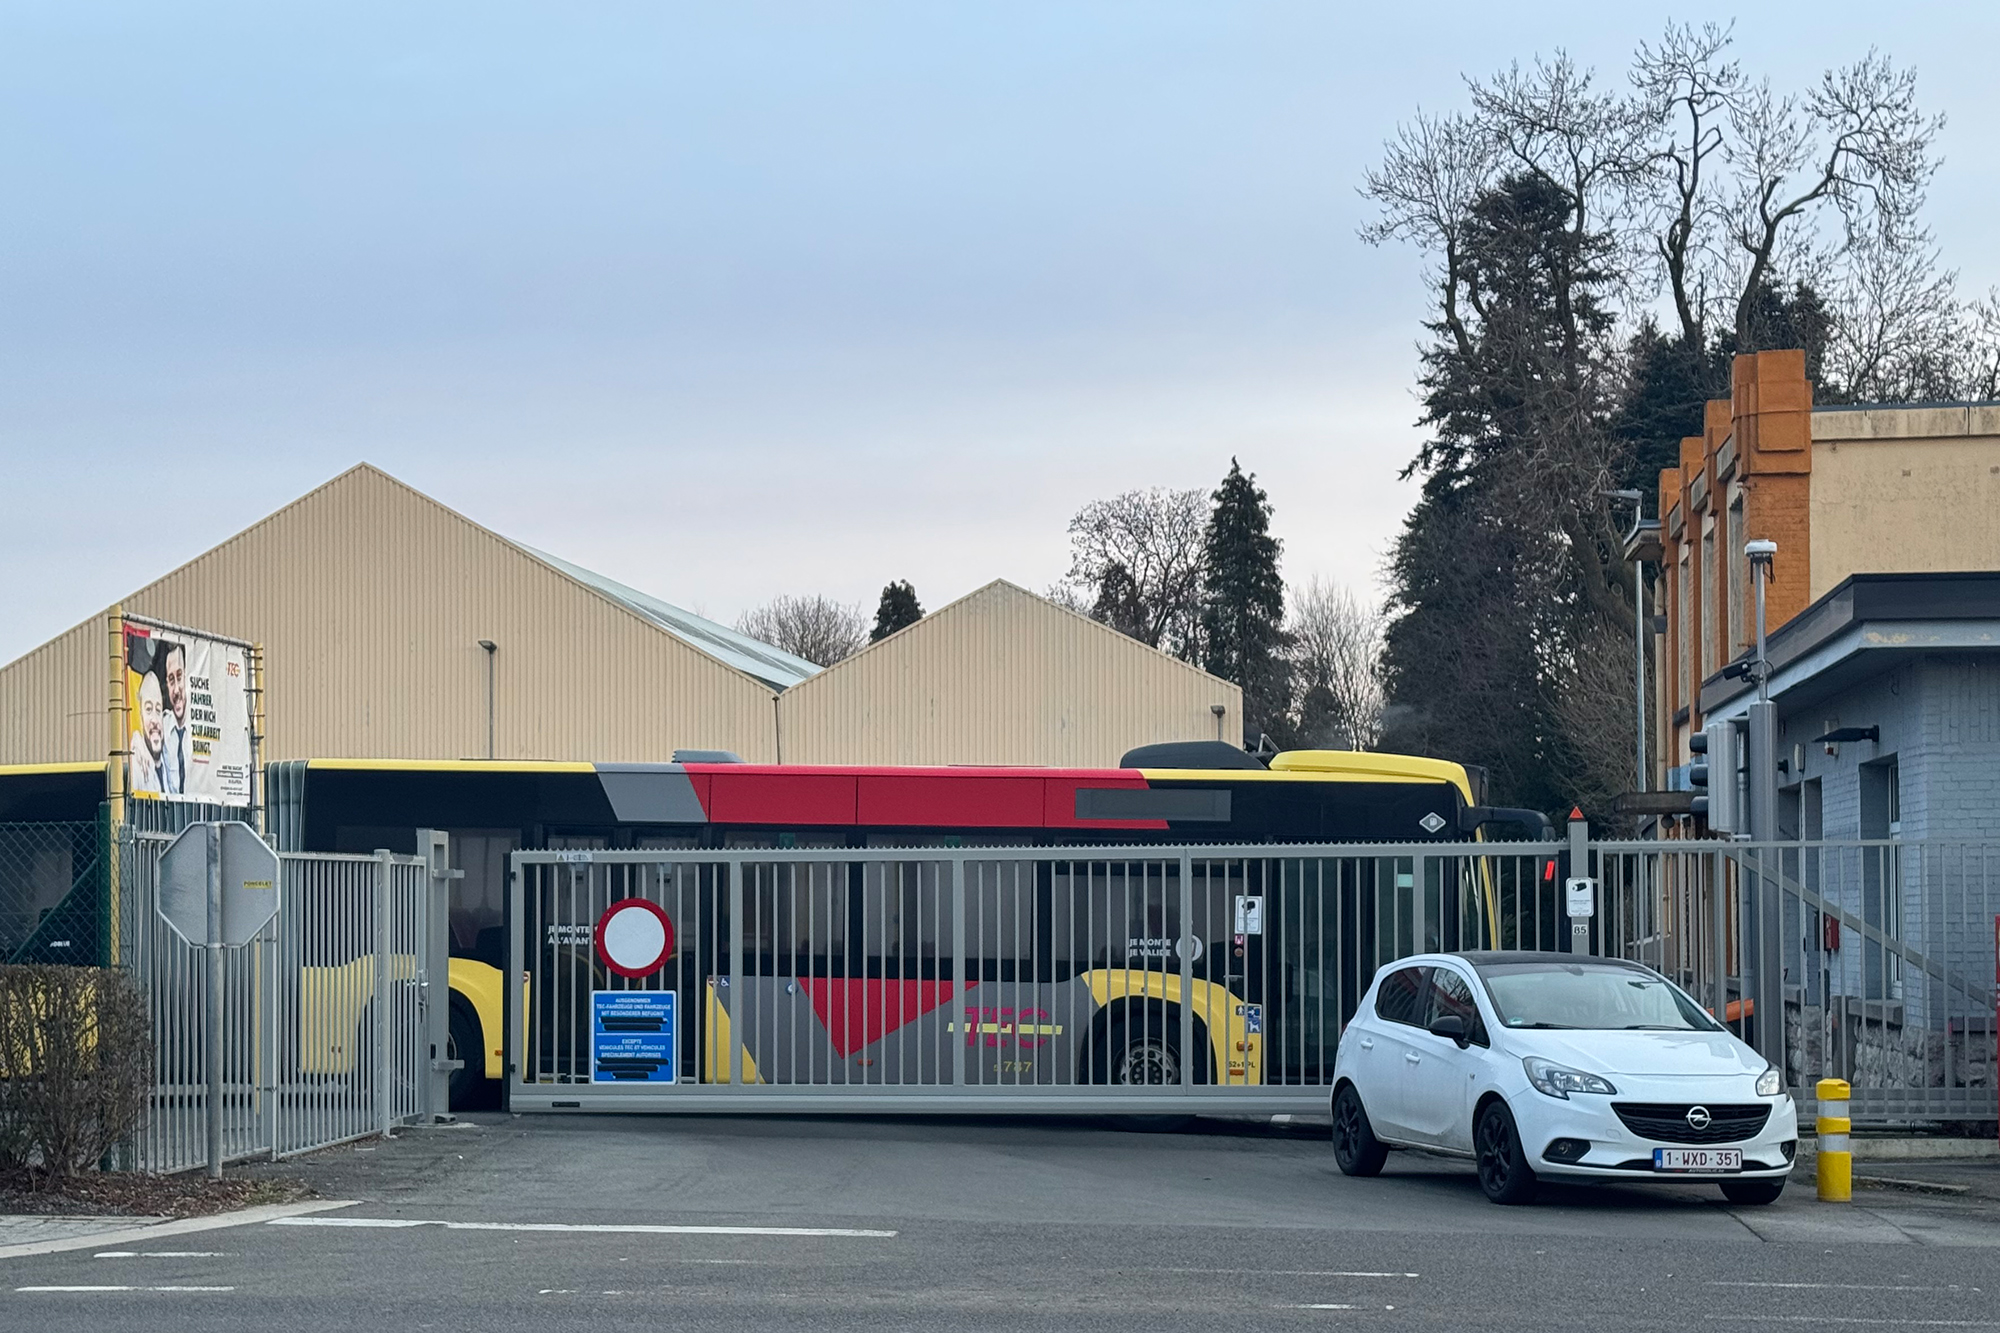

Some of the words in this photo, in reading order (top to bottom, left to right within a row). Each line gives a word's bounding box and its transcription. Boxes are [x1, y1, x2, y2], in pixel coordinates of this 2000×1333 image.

[227, 662, 240, 677] TEC
[190, 676, 210, 691] SUCHE
[190, 692, 214, 710] FAHRER,
[190, 708, 203, 721] DER
[203, 711, 216, 724] MICH
[191, 725, 203, 738] ZUR
[204, 728, 221, 741] ARBEIT
[192, 741, 212, 755] BRINGT.
[547, 925, 555, 935] JE
[556, 936, 592, 945] 'AVAN
[1129, 938, 1138, 947] JE
[1129, 949, 1138, 958] JE
[964, 1007, 1048, 1048] TEC
